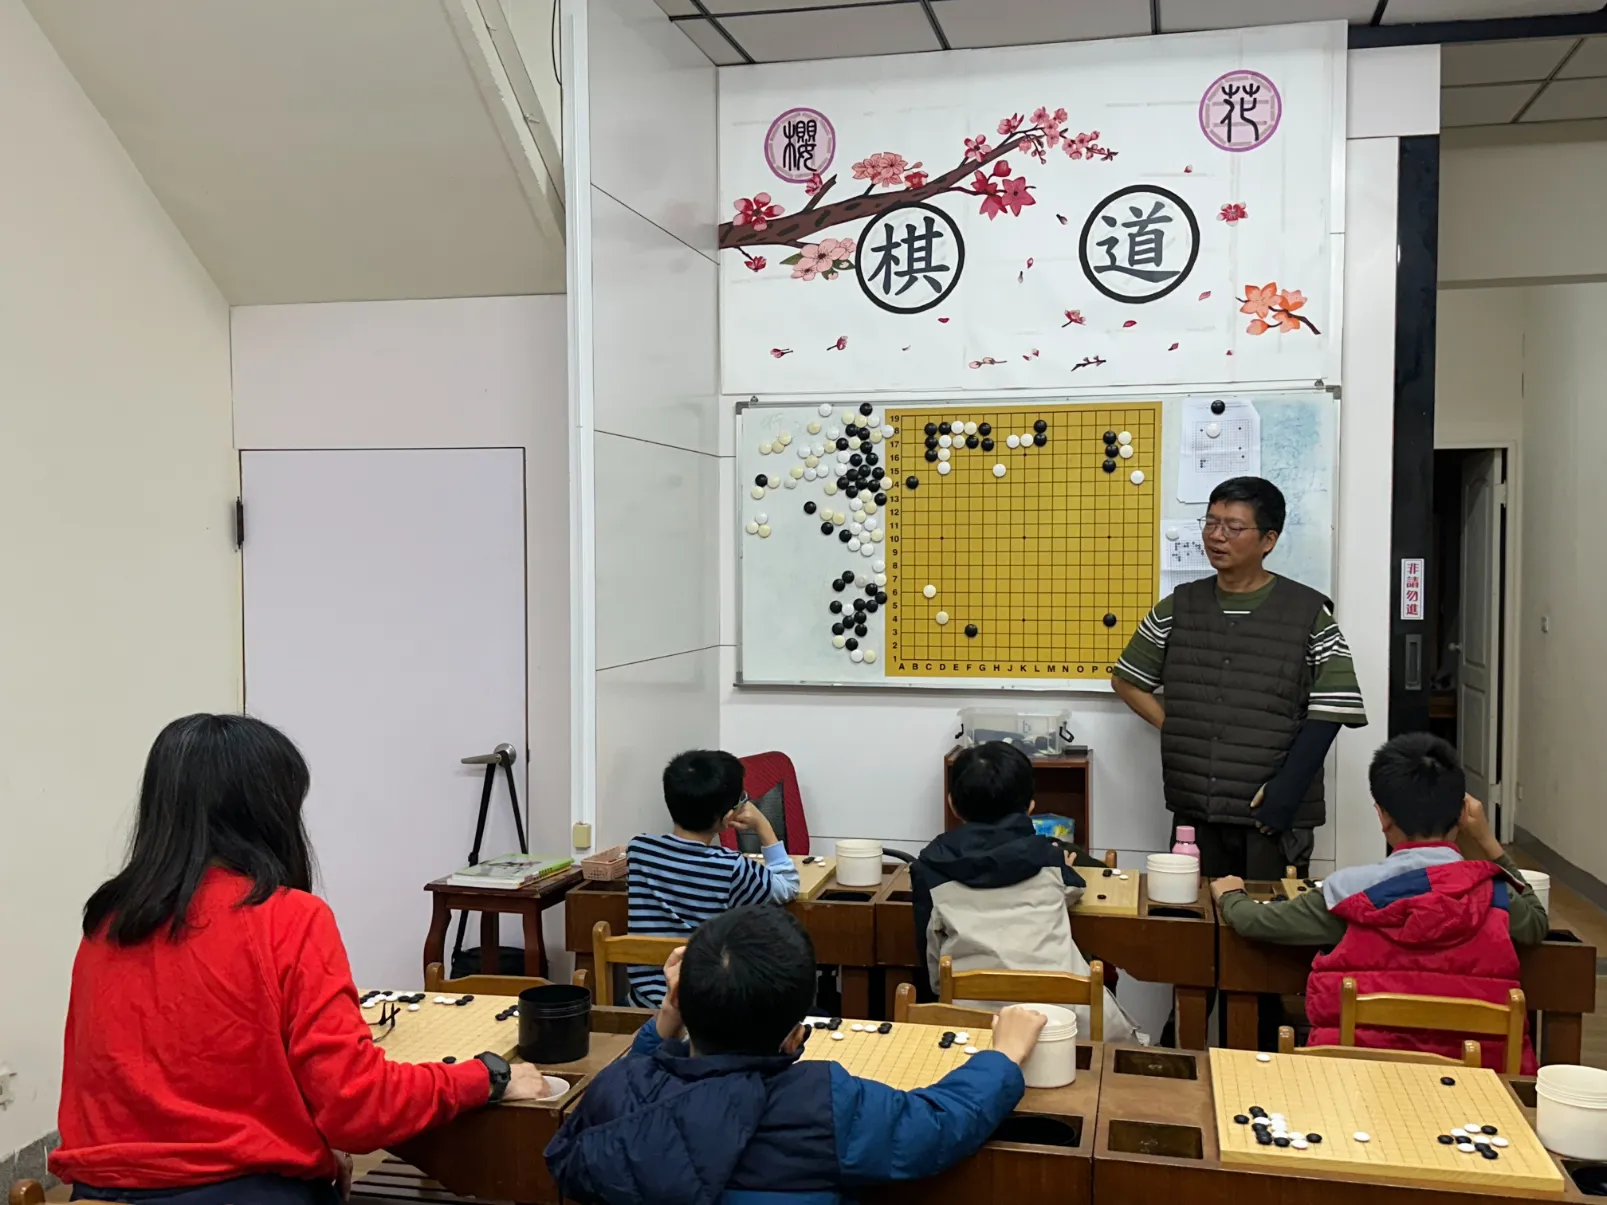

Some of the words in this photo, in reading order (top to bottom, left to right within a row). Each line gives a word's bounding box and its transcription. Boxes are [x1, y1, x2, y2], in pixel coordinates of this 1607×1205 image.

[1220, 83, 1260, 143] 花
[867, 216, 950, 296] 棋
[1093, 201, 1181, 283] 道
[890, 522, 899, 530] 11
[892, 562, 898, 570] 8
[1406, 563, 1419, 615] 非請勿進
[939, 663, 946, 671] D
[979, 664, 986, 672] G
[1047, 665, 1055, 673] M
